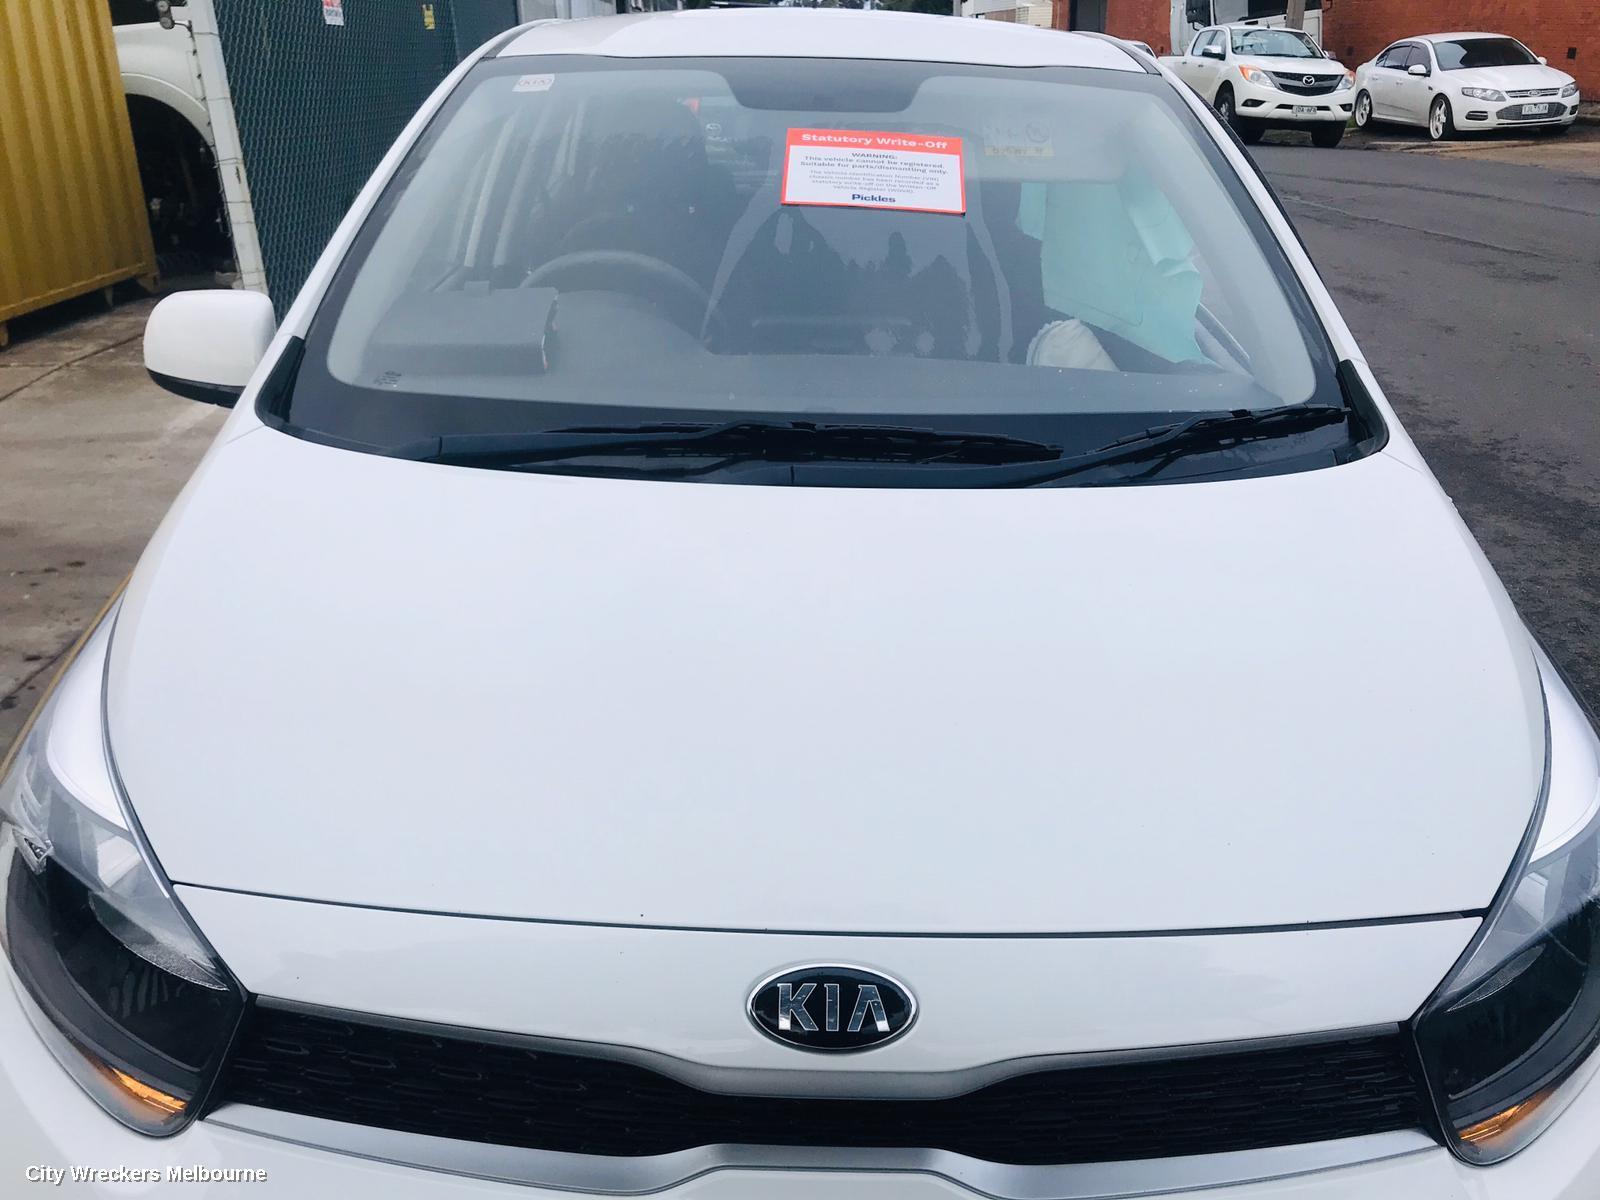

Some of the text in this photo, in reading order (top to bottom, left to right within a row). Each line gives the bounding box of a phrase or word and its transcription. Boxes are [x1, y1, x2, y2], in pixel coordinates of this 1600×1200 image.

[802, 134, 948, 149] Statutory Write-Off
[852, 164, 927, 173] parts/dismantling
[852, 193, 896, 203] Pickles
[777, 983, 890, 1032] KIA
